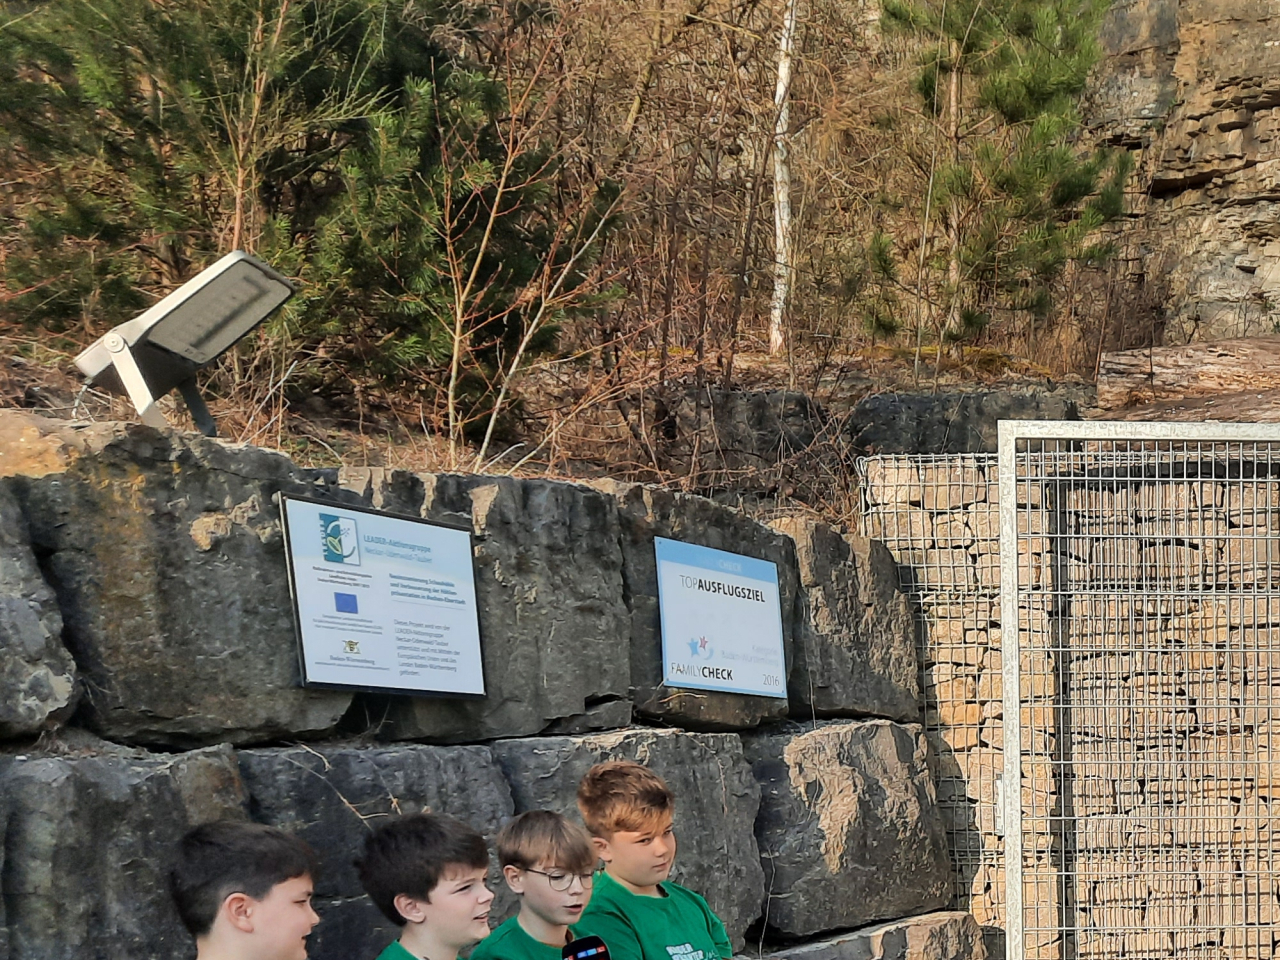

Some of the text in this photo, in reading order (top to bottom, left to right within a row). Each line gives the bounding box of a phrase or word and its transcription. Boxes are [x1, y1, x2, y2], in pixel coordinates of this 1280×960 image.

[679, 574, 766, 603] TOPAUSFLUGSZIEL
[671, 662, 734, 681] FAMILYCHECK
[762, 673, 780, 687] 2016
